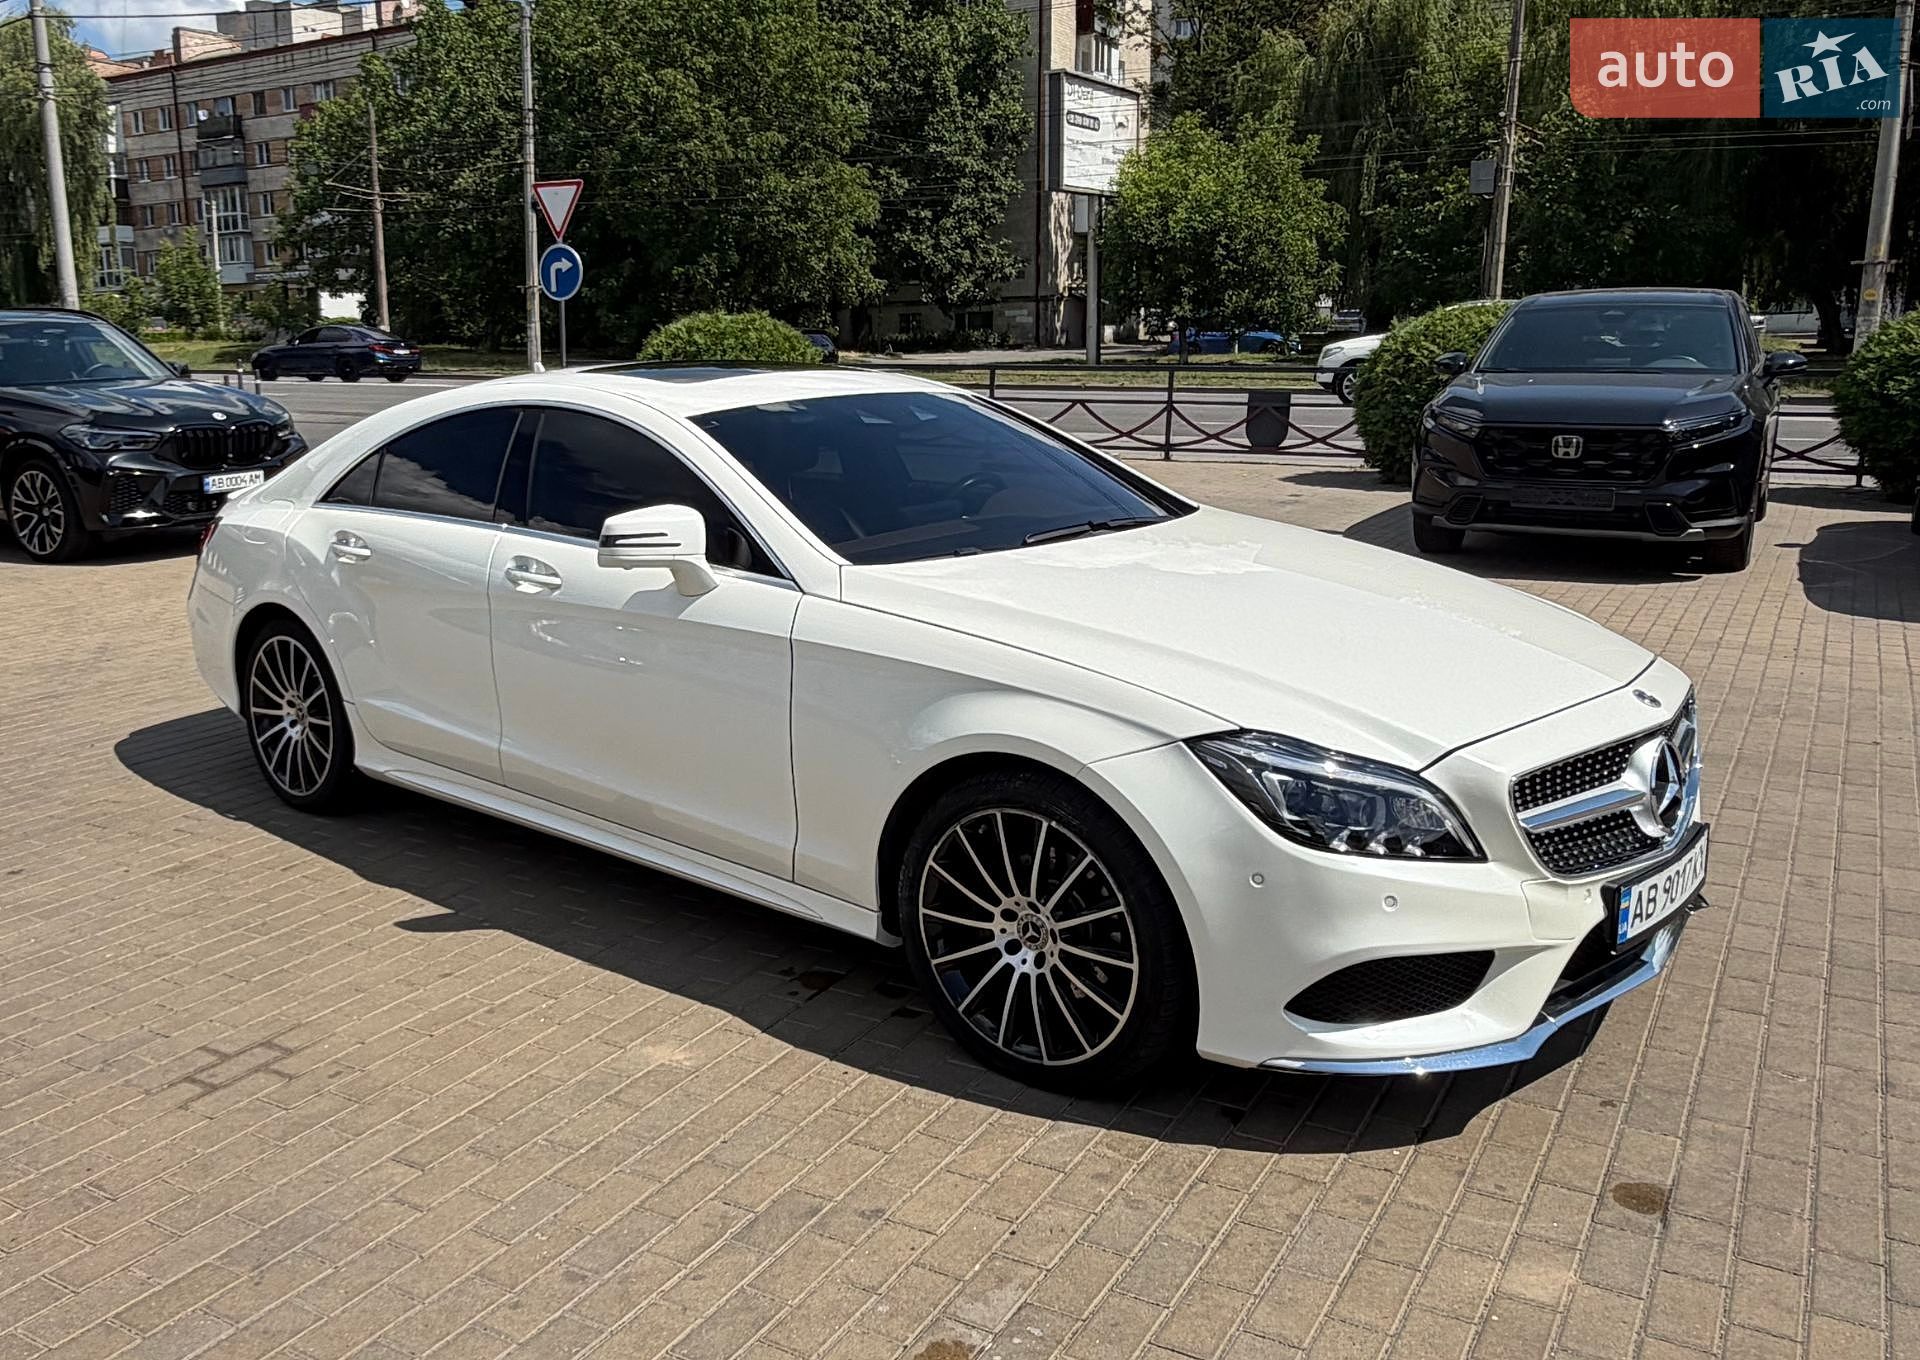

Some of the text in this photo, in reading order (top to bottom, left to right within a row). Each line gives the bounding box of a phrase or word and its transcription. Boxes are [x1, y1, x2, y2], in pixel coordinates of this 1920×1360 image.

[212, 477, 224, 489] AB
[226, 475, 247, 487] 0004
[1630, 884, 1659, 928] AB
[1661, 857, 1694, 912] 9017
